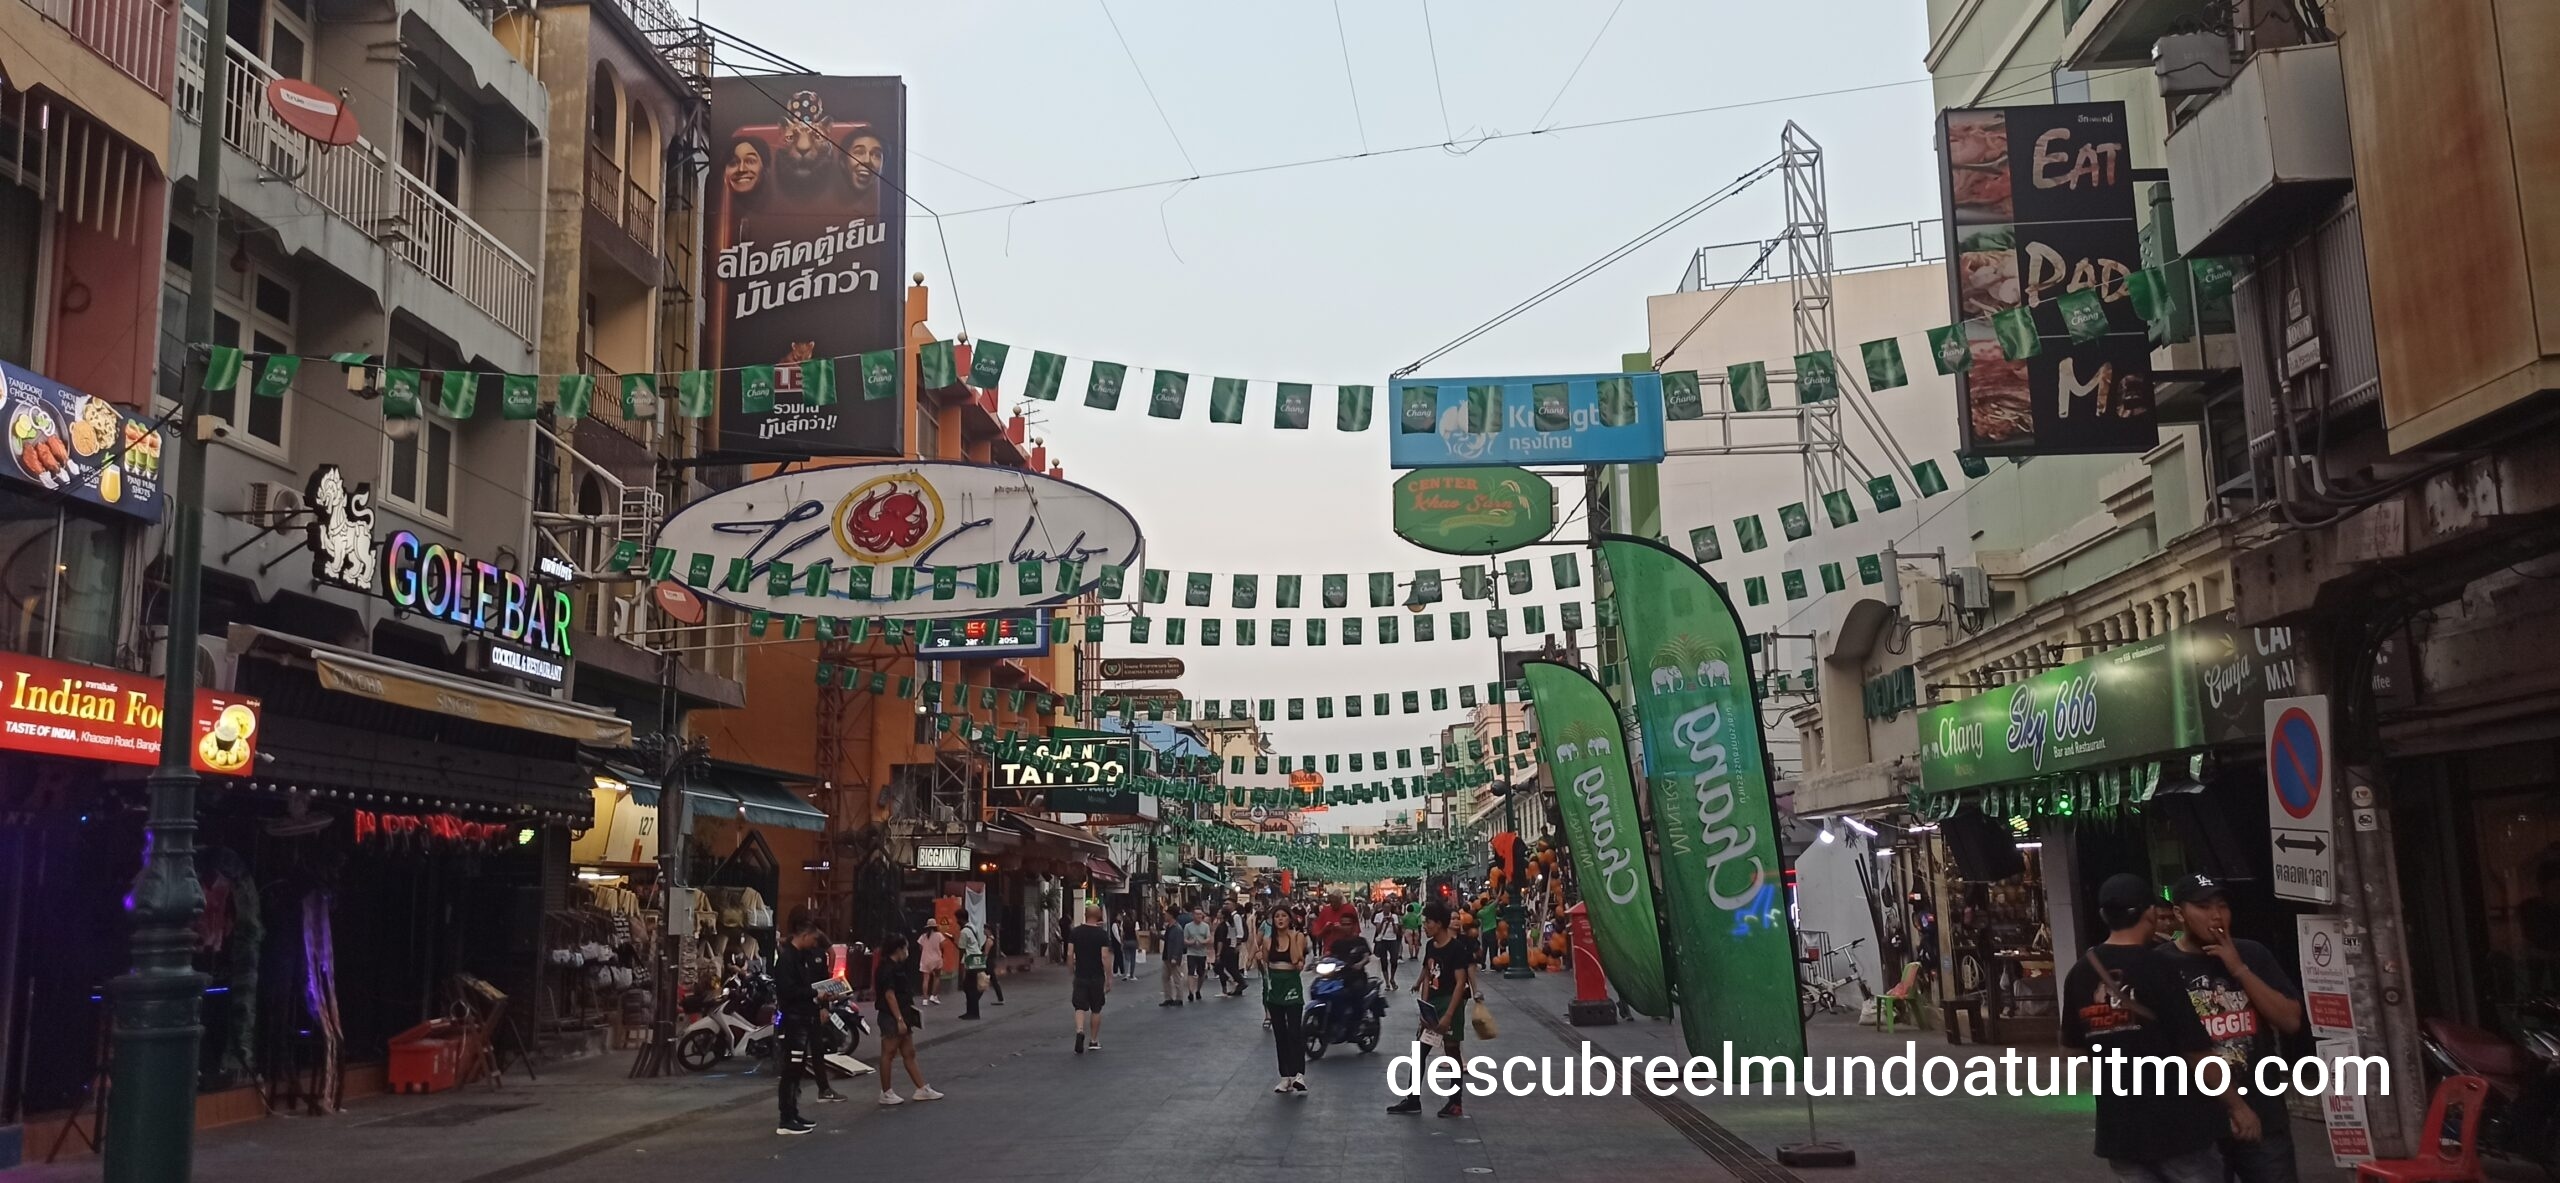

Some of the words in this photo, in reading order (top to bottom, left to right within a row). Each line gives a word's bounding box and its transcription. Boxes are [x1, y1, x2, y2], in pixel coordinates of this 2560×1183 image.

[717, 218, 886, 279] ลีโอติดตู้เย็น
[2205, 269, 2232, 283] Chang
[736, 262, 879, 319] มันส์กว่า
[2071, 311, 2099, 326] Chang
[868, 374, 893, 384] Chang
[975, 363, 998, 376] Chang
[1804, 376, 1831, 386] Chang
[1156, 392, 1180, 404] Chang
[1670, 394, 1696, 404] Chang
[1280, 403, 1305, 415] Chang
[1406, 408, 1432, 418] Chang
[1538, 405, 1565, 415] Chang
[1509, 432, 1572, 455] กรุงไทย
[1408, 476, 1478, 493] CENTER
[389, 530, 498, 630] GOLF
[502, 572, 571, 656] BAR
[492, 646, 522, 671] COCKTAIL
[526, 657, 563, 682] RESTAURANT
[2204, 654, 2250, 709] Ganja
[10, 671, 115, 723] Indian
[2007, 685, 2048, 771] Sky
[2053, 670, 2097, 742] 666
[5, 721, 37, 734] TASTE
[36, 725, 51, 736] OF
[80, 732, 113, 746] Khaosan
[1939, 716, 1983, 759] Chang
[2053, 746, 2065, 759] Bar
[2064, 743, 2075, 756] and
[2075, 736, 2106, 755] Restaurant
[640, 816, 653, 836] 127
[920, 848, 957, 867] BIGGAINK
[2275, 863, 2329, 888] ตลอดเวลา
[2201, 1012, 2251, 1037] IGGIE
